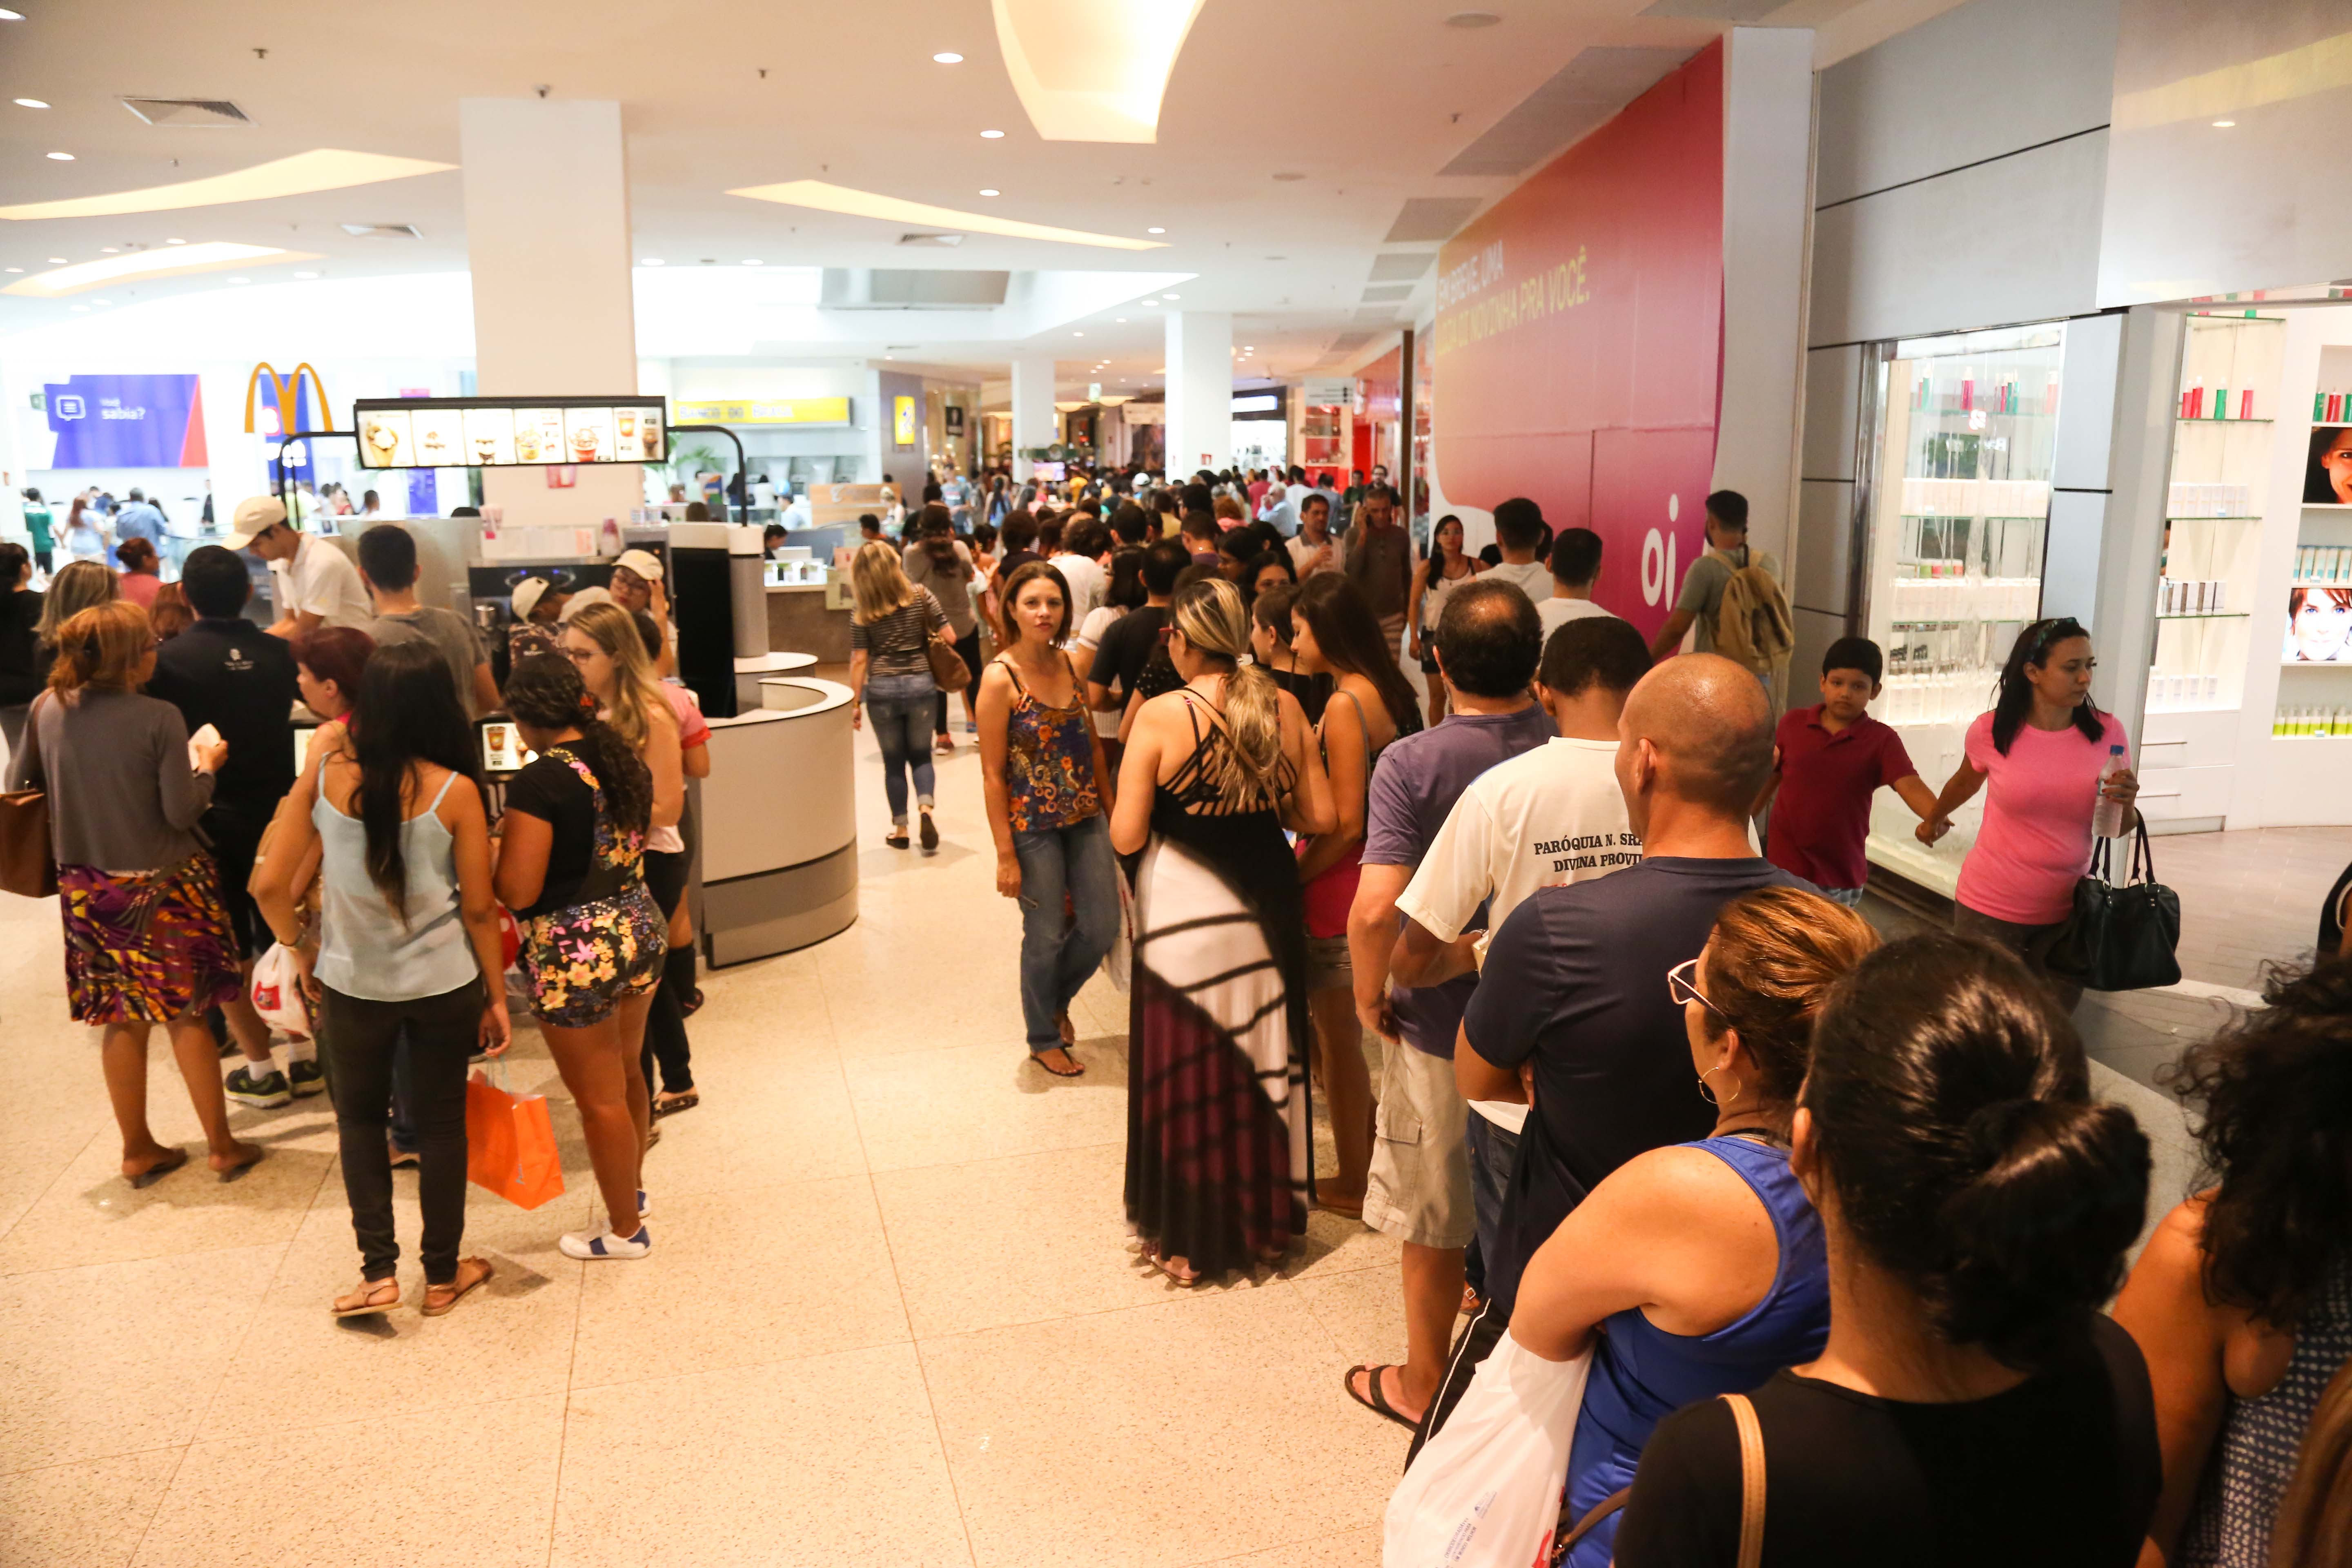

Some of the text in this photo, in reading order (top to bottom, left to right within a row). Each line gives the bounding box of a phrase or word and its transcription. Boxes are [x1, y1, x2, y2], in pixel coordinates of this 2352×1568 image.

[1520, 274, 1545, 325] PRA
[1548, 244, 1590, 314] VOCÊ.
[1534, 835, 1603, 855] PARÓQUIA
[1606, 834, 1616, 846] N.
[1553, 856, 1597, 872] DIVINA
